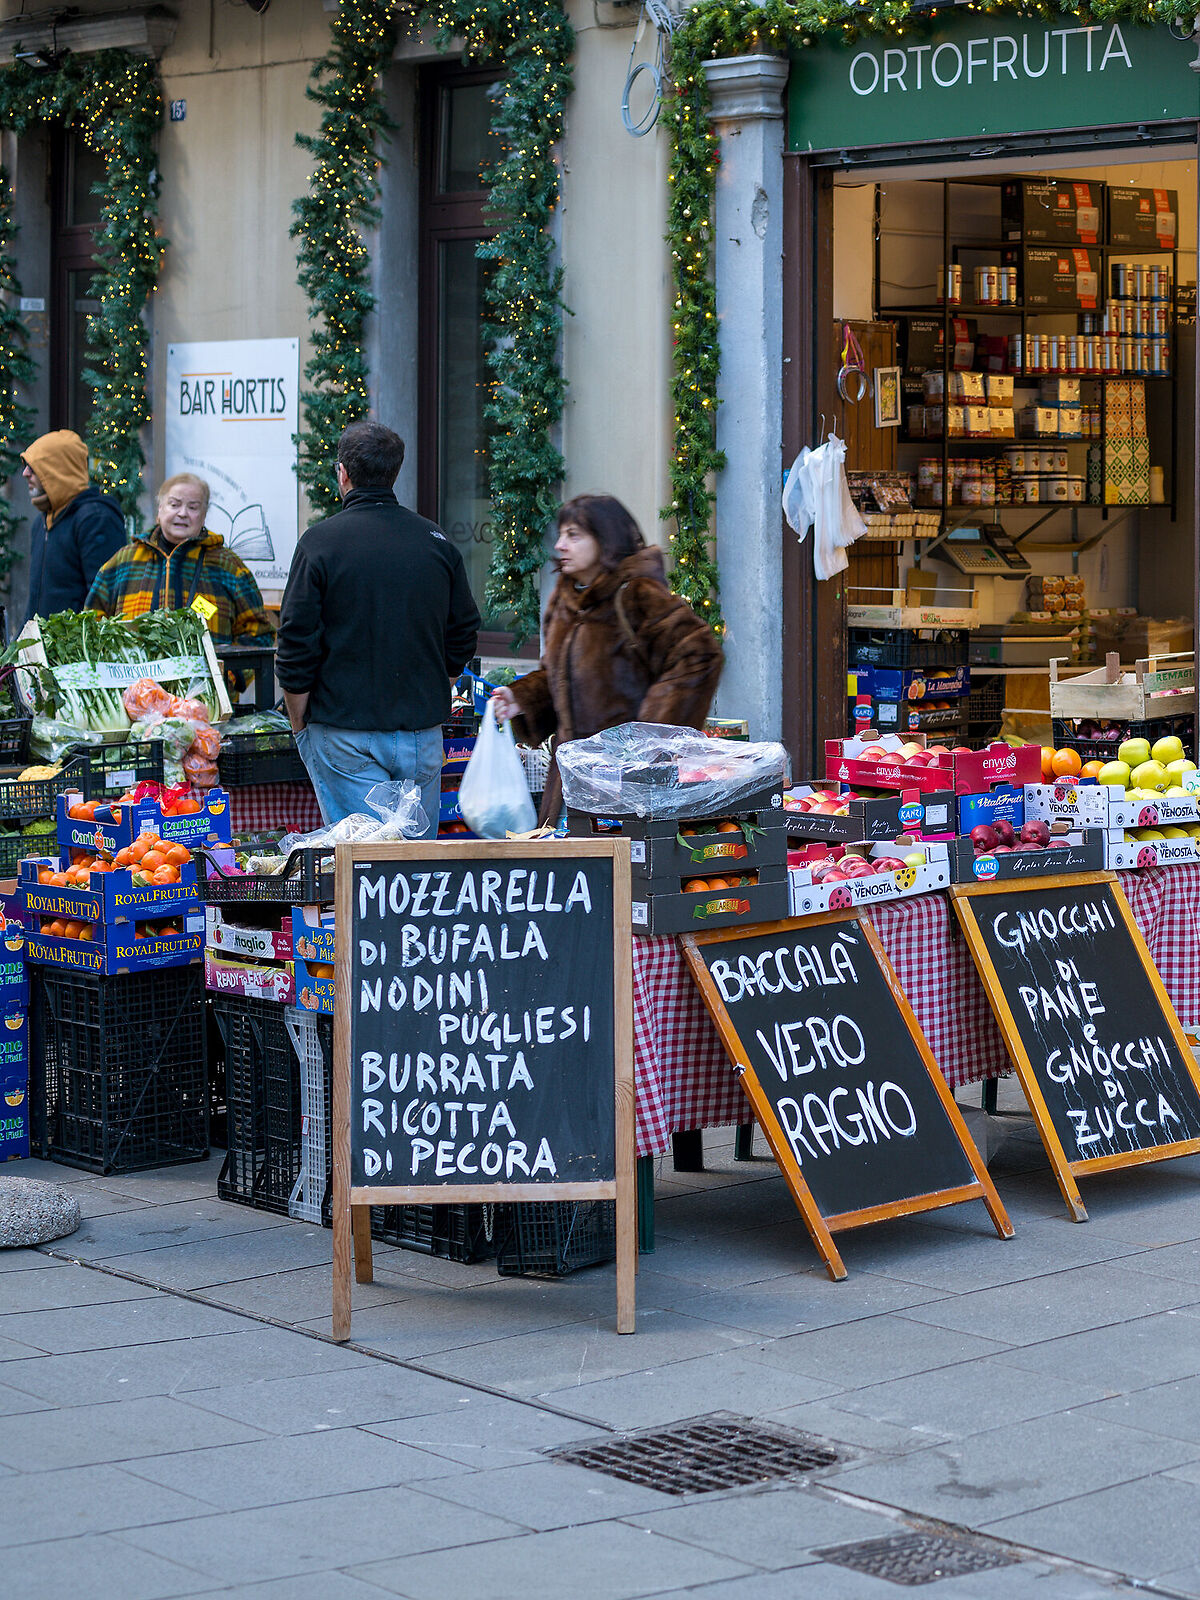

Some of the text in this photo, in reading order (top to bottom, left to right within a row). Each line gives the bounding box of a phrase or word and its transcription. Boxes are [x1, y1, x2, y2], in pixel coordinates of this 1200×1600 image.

[849, 23, 1133, 96] ORTOFRUTTA
[180, 377, 286, 415] BAR HORTIS
[983, 757, 1006, 773] envy
[163, 817, 210, 832] Carbone
[1049, 804, 1080, 813] VENOSTA
[1161, 806, 1194, 818] VENOSTA
[1160, 847, 1192, 859] VENOSTA
[26, 893, 99, 919] ROYALFRUTTA
[115, 883, 198, 906] ROYALFRUTTA
[359, 869, 592, 919] MOZZARELLA
[854, 884, 892, 898] VENOSTA
[326, 932, 335, 946] D
[359, 920, 549, 968] DI BUFALA
[992, 899, 1116, 951] GNOCCHI
[28, 941, 101, 970] ROYALFRUTTA
[116, 934, 200, 958] ROYALFRUTTA
[216, 970, 240, 988] READY
[248, 970, 264, 986] EAT
[1057, 957, 1082, 982] DI
[360, 968, 489, 1013] NODINI
[1019, 982, 1106, 1022] PANE
[438, 1005, 590, 1051] PUGLIESI
[754, 1013, 867, 1083] VERO
[1045, 1036, 1172, 1084] GNOCCHI
[361, 1051, 535, 1094] BURRATA
[1103, 1080, 1124, 1099] DI
[361, 1098, 517, 1138] RICOTTA
[776, 1080, 917, 1166] RAGNO
[1065, 1099, 1181, 1146] ZUCCA
[363, 1137, 559, 1178] DI PECORA
